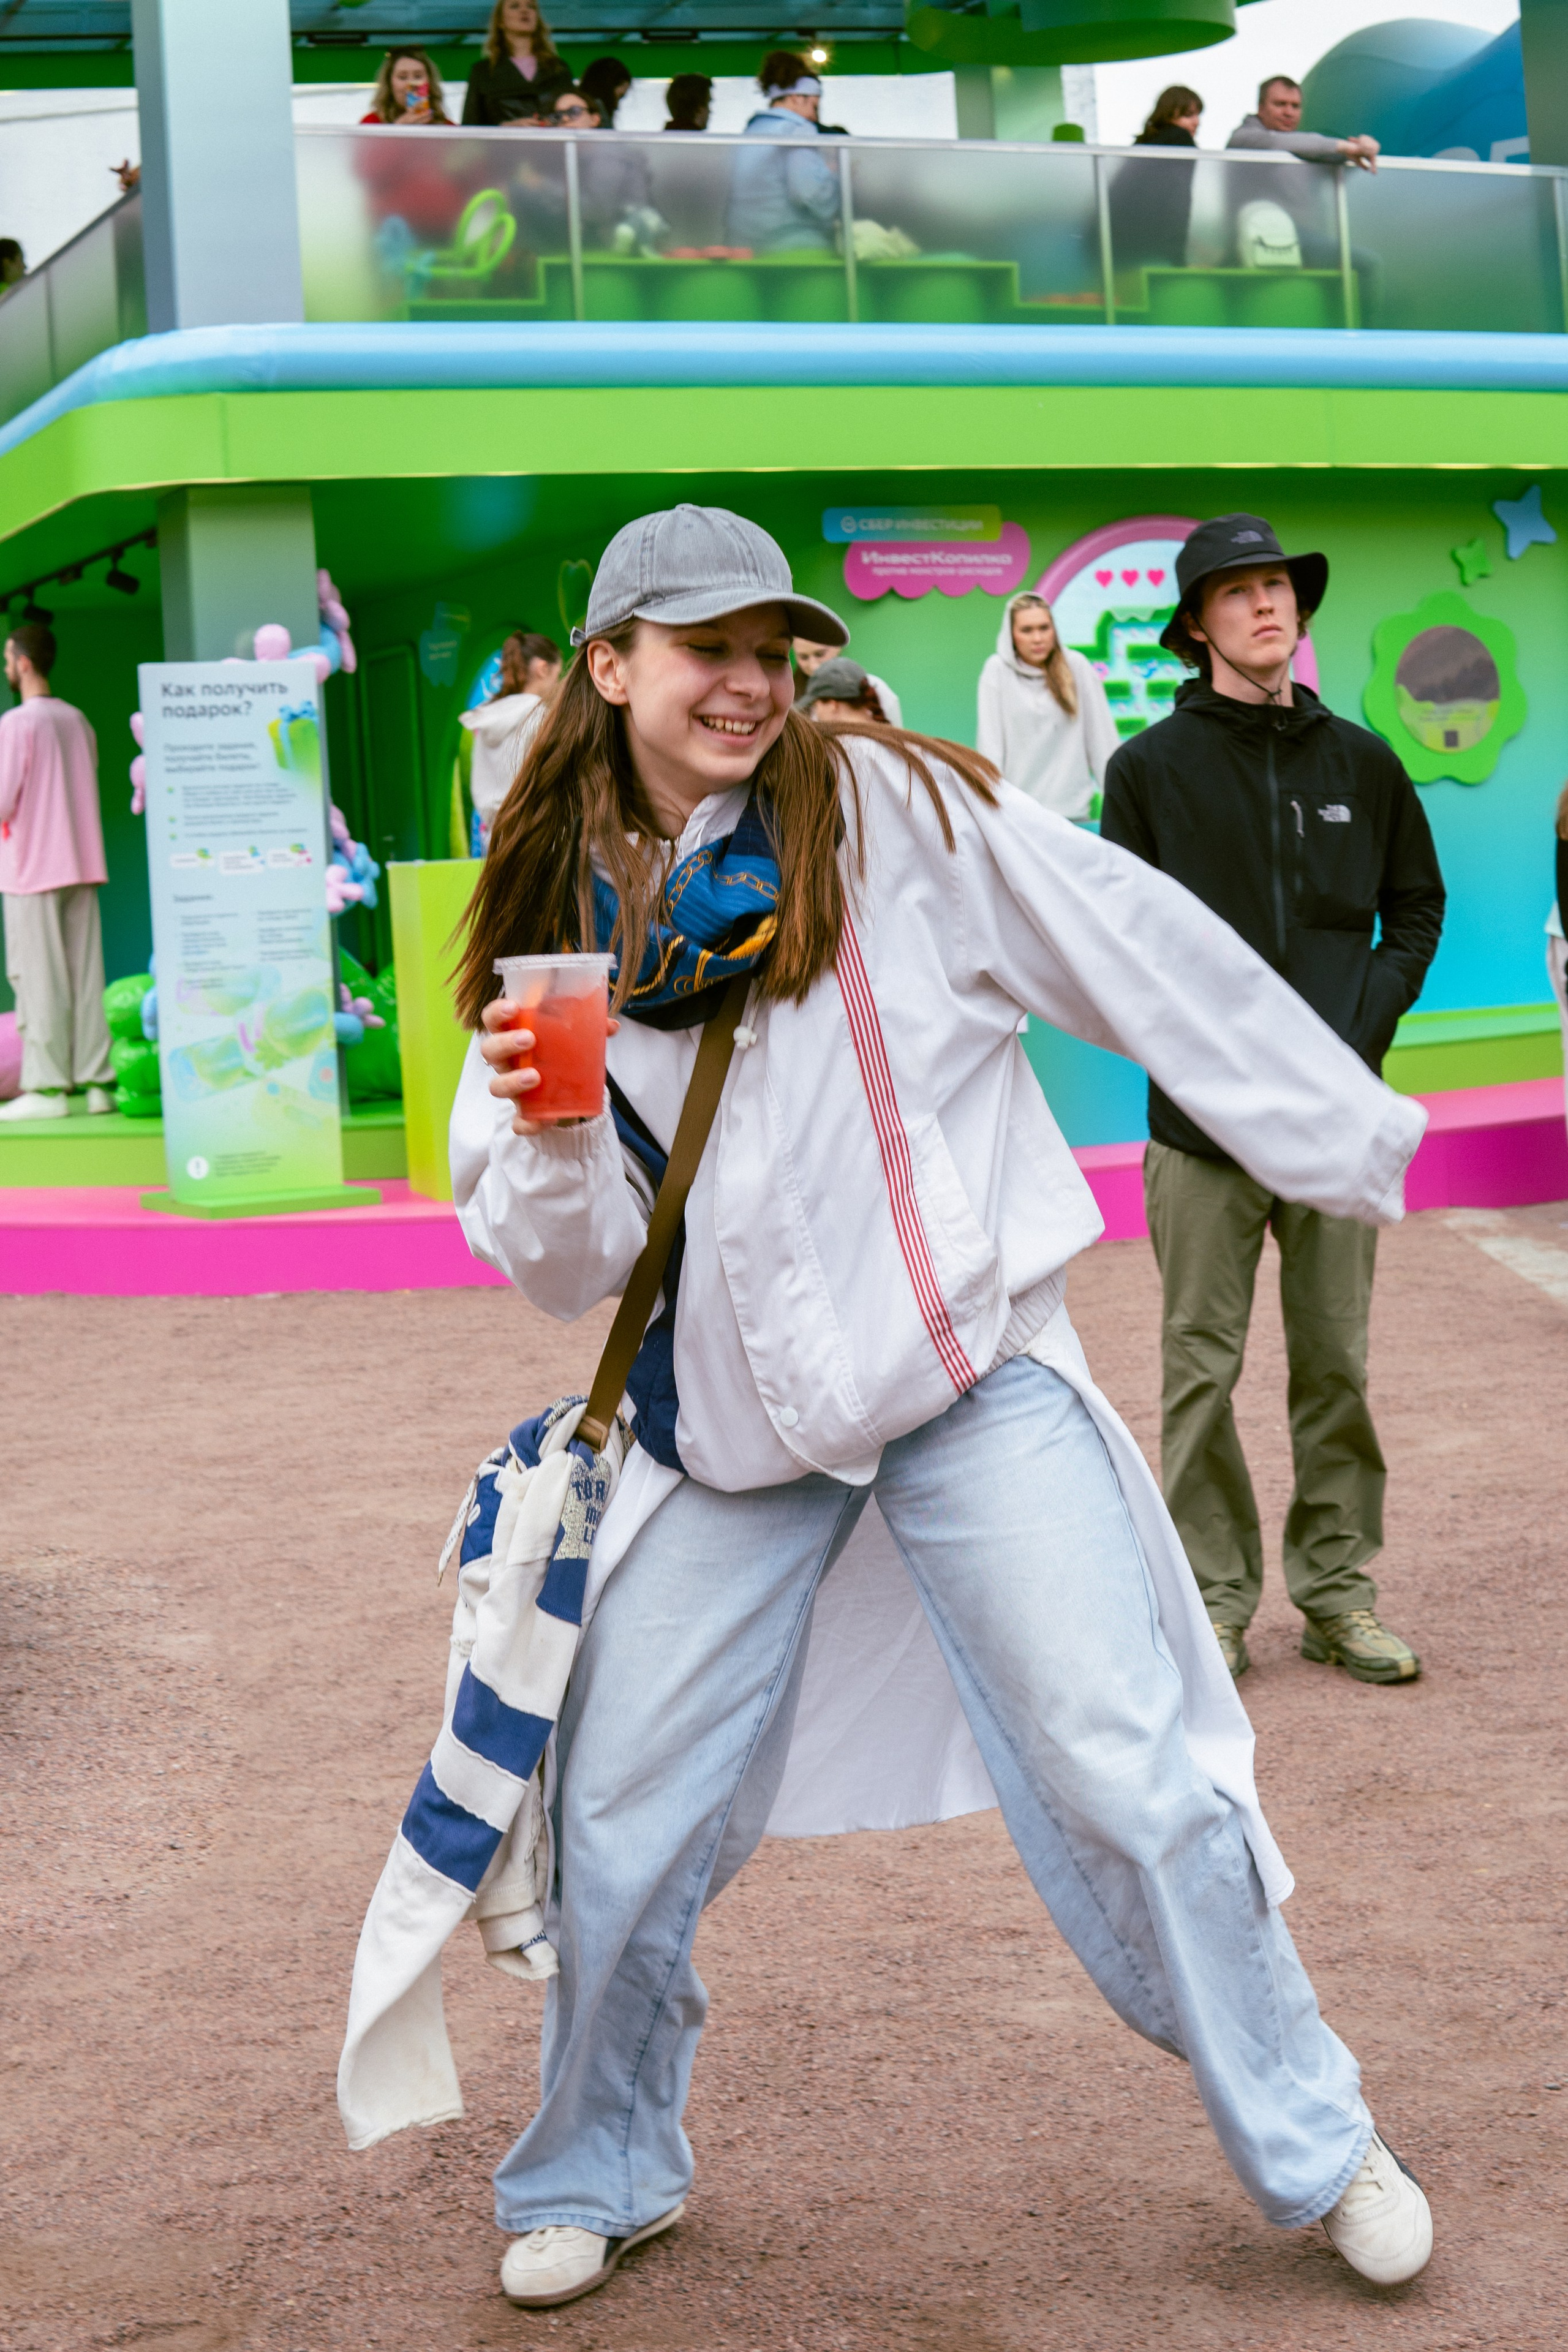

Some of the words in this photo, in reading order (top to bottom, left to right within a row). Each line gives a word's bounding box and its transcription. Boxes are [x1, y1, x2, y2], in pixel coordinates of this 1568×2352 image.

[861, 551, 1012, 565] ИнвестКопилка
[161, 683, 194, 697] Как
[200, 682, 288, 699] получить
[162, 701, 253, 718] подарок?
